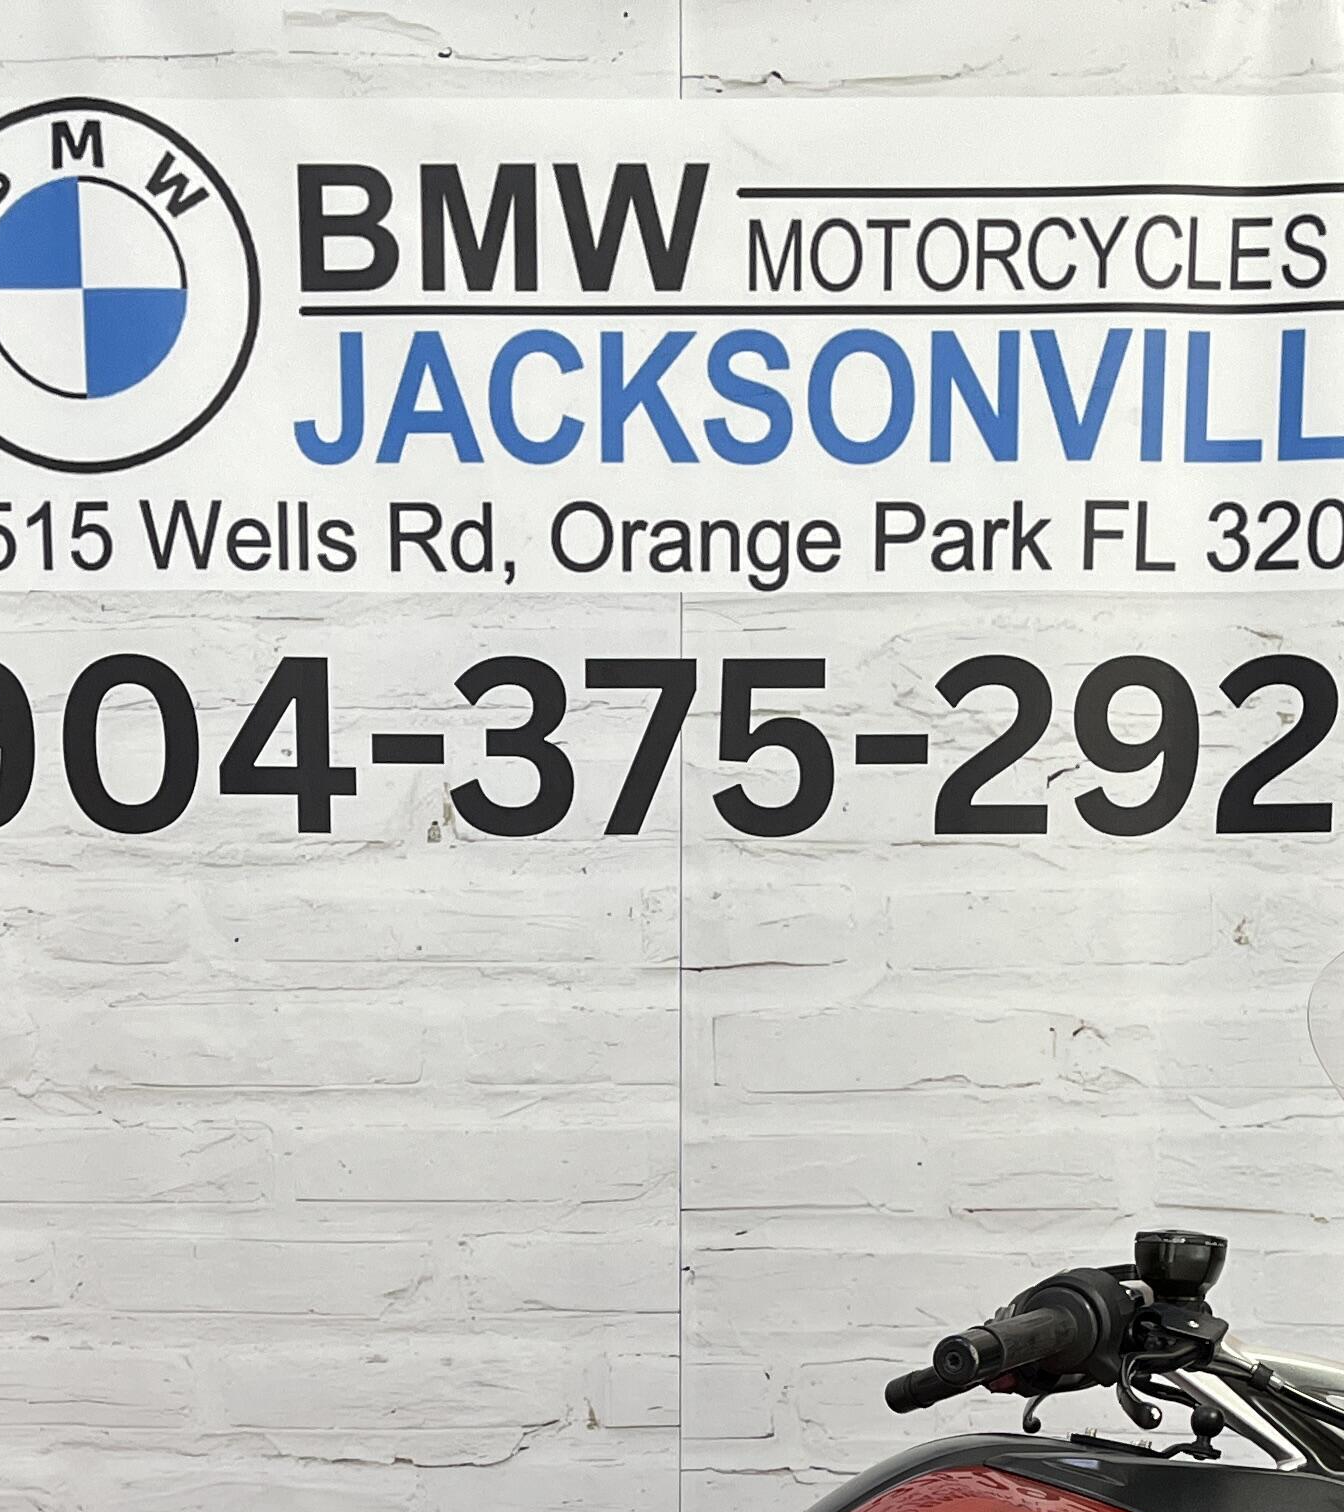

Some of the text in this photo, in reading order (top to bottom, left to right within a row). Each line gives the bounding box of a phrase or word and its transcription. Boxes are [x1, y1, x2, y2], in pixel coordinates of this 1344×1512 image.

[298, 163, 709, 292] BMW
[749, 215, 1326, 291] MOTORCYCLES
[140, 500, 356, 572] Wells
[390, 502, 514, 584] Rd,
[552, 501, 841, 591] Orange
[876, 501, 1052, 571] Park
[1084, 500, 1175, 571] FL
